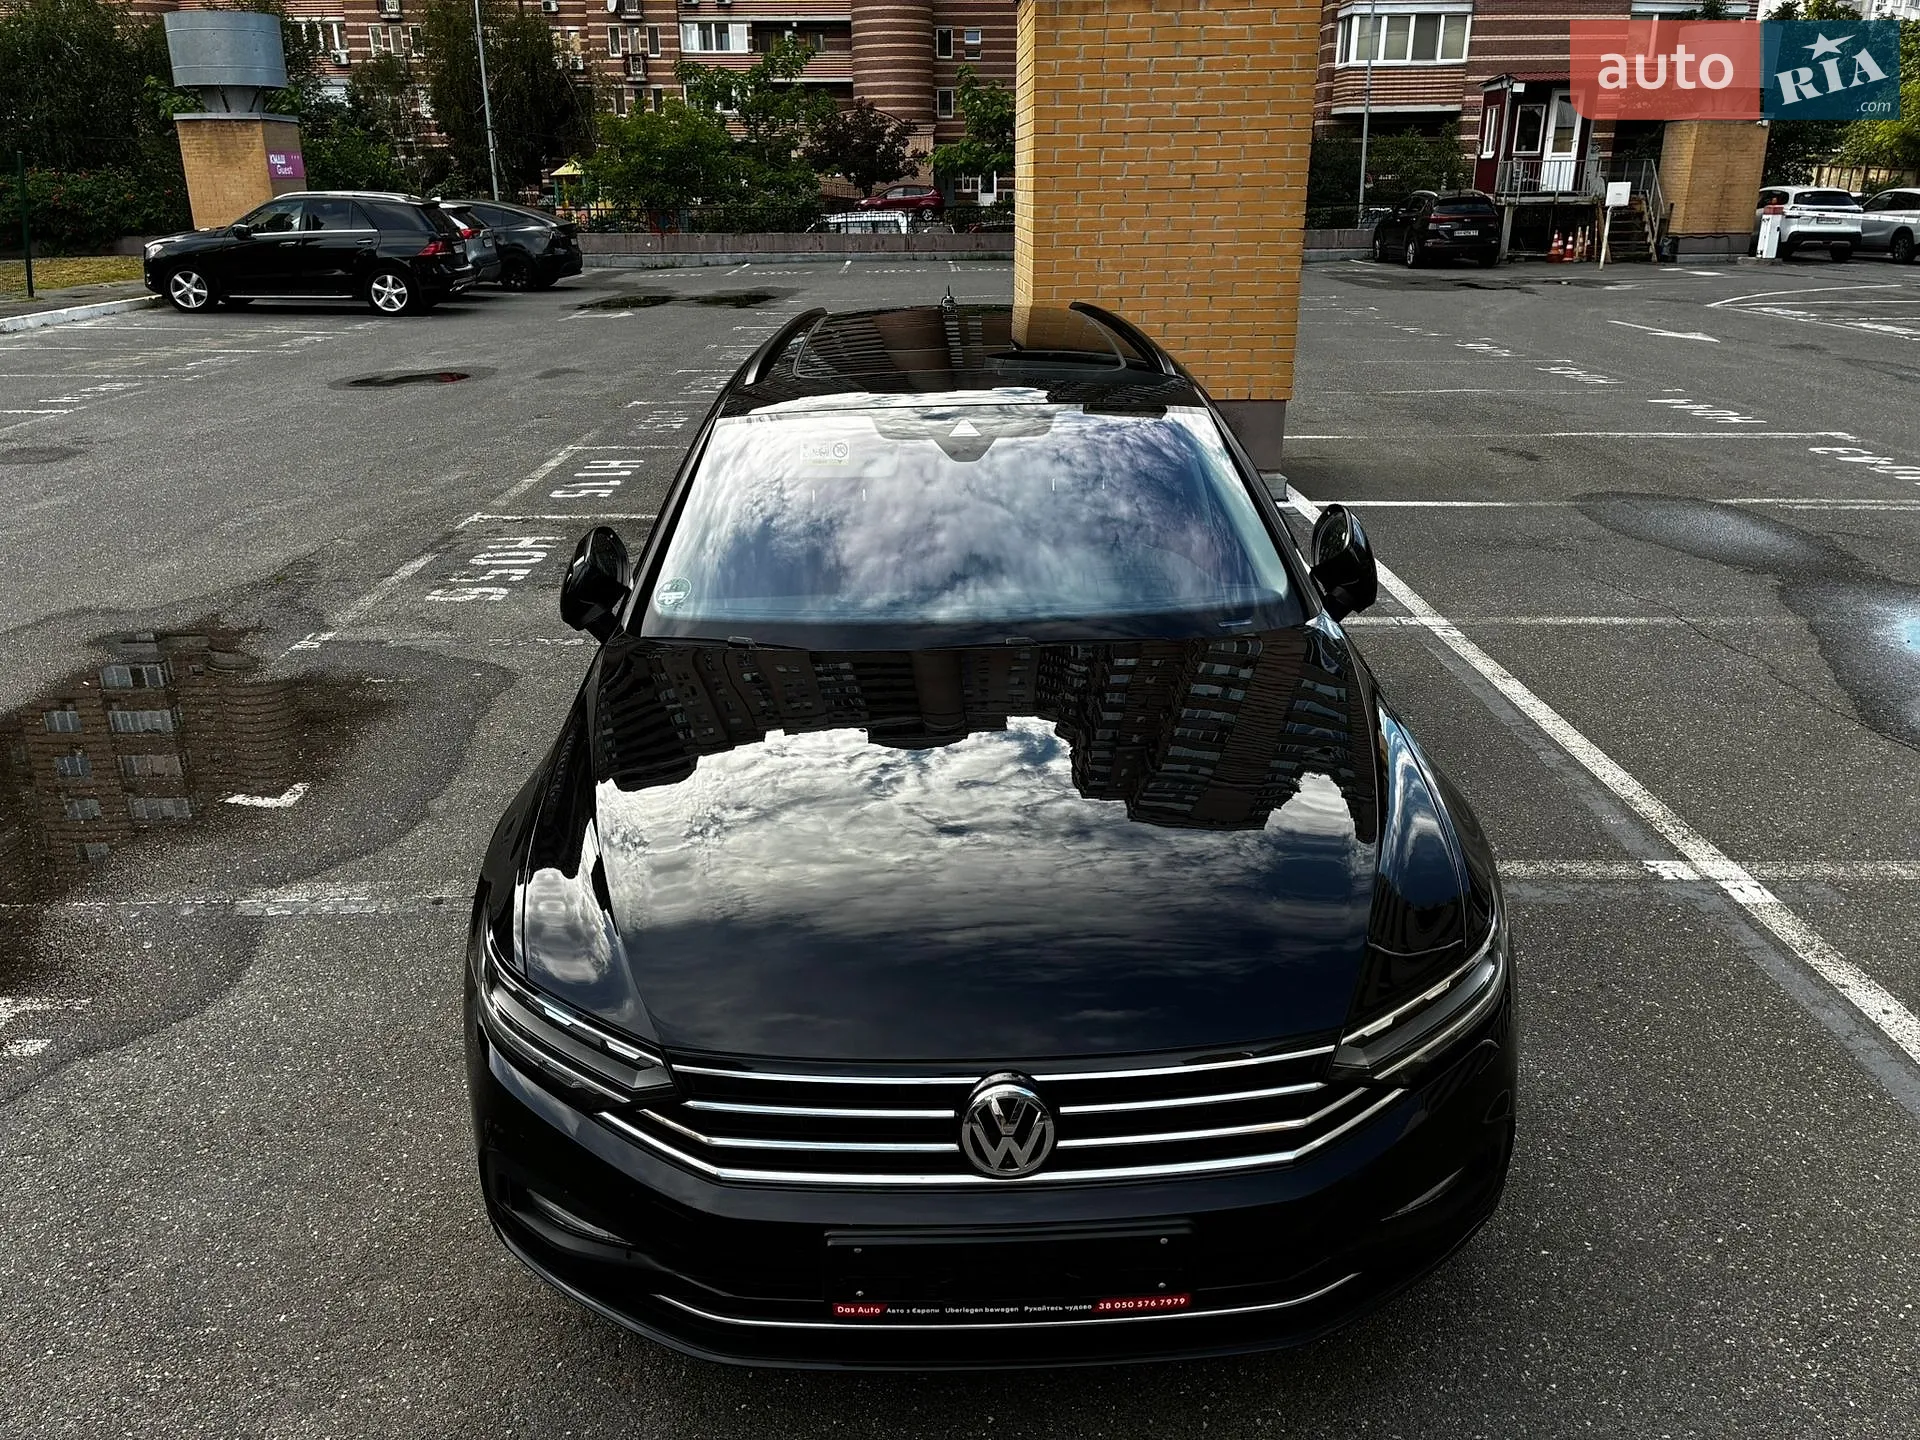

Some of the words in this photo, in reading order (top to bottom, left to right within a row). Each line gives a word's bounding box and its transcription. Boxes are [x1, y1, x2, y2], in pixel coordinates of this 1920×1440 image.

[1098, 1302, 1111, 1310] 38
[1114, 1301, 1135, 1309] 050
[1137, 1300, 1157, 1308] 576
[1160, 1297, 1186, 1306] 7979
[837, 1305, 855, 1313] Das
[858, 1306, 880, 1314] Auto
